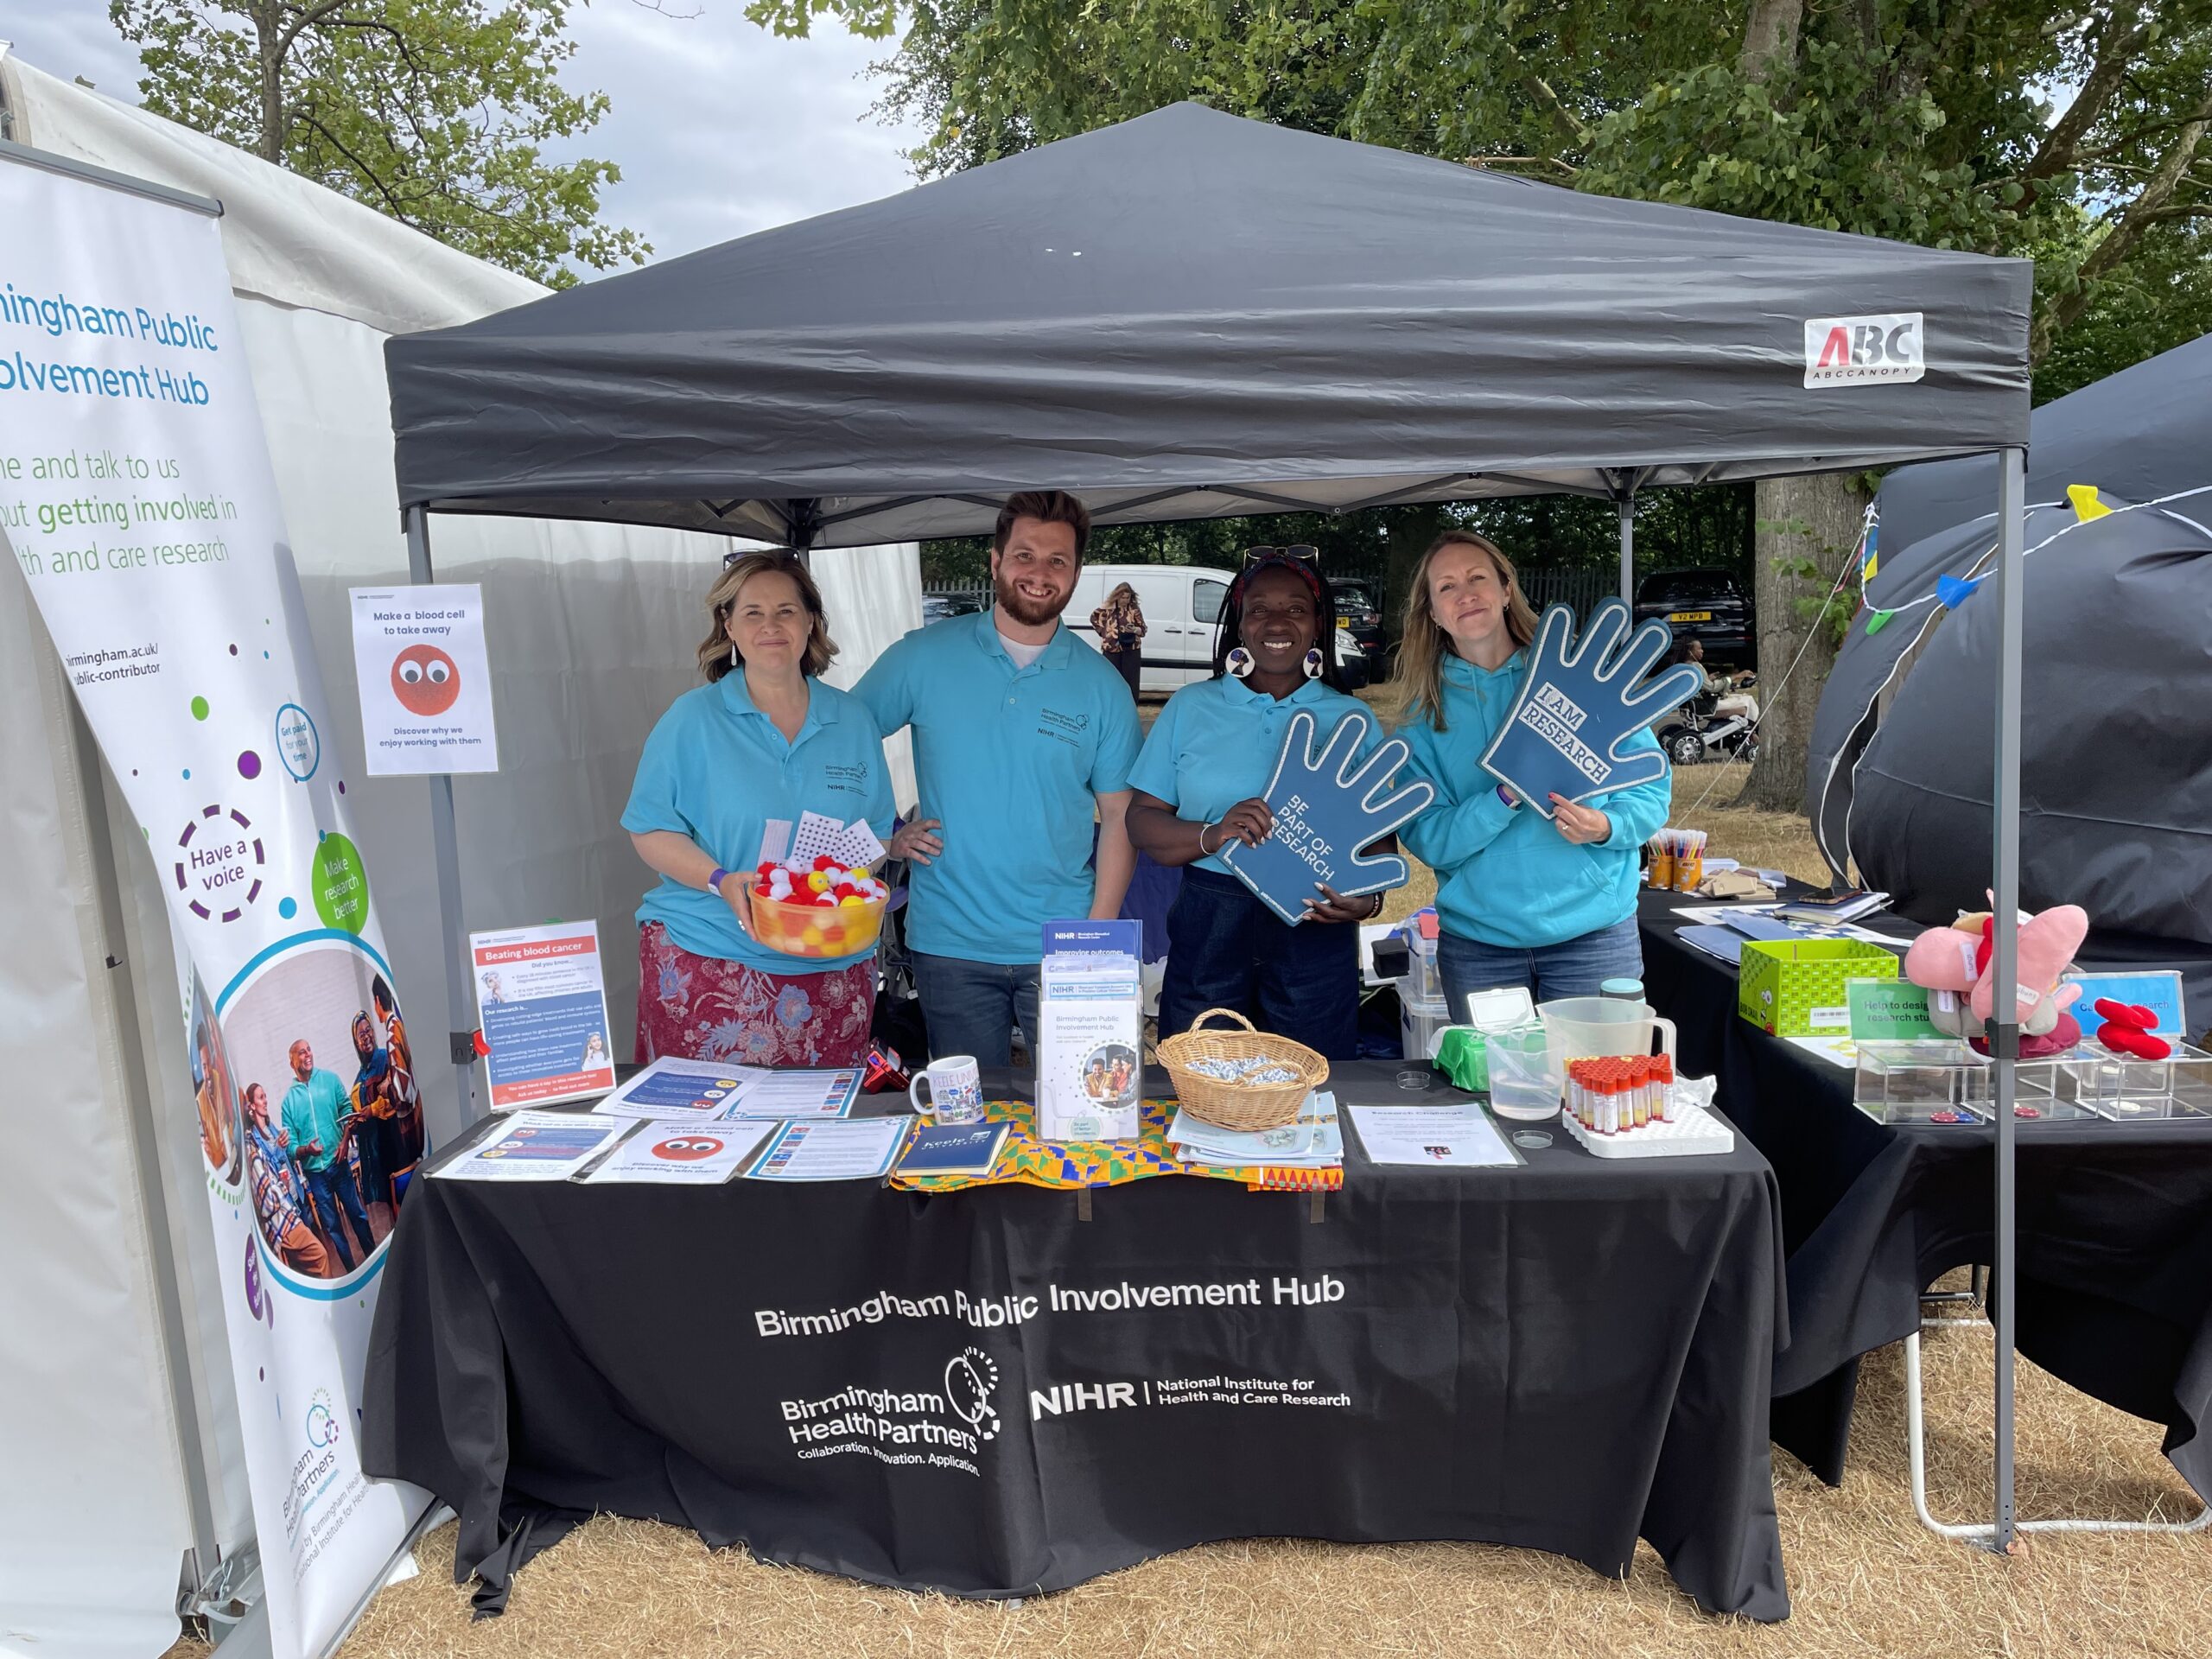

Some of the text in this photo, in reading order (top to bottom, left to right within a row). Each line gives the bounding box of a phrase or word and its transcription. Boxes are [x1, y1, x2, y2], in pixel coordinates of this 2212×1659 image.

[136, 308, 219, 352] Public
[1816, 322, 1913, 368] ABC
[1813, 366, 1911, 379] ABCCANOPY
[156, 368, 210, 405] Hub
[32, 449, 79, 479] and
[85, 449, 122, 479] talk
[125, 454, 149, 479] to
[157, 457, 180, 478] us
[38, 495, 129, 533] getting
[134, 493, 219, 522] involved
[221, 495, 238, 519] in
[52, 542, 100, 574] and
[107, 546, 146, 569] care
[153, 535, 230, 565] research
[373, 612, 402, 621] Make
[415, 611, 444, 620] blood
[447, 610, 465, 619] cell
[384, 626, 451, 636] to take away
[1538, 687, 1584, 727] I AM
[292, 722, 307, 735] paid
[431, 728, 448, 737] why
[1037, 728, 1055, 738] NIHR
[379, 740, 403, 748] enjoy
[404, 738, 438, 747] working
[439, 737, 457, 746] with
[1523, 706, 1609, 782] RESEARCH
[1287, 794, 1310, 817] BE
[1277, 806, 1333, 856] PART OF
[190, 840, 248, 870] Have a
[1271, 819, 1335, 881] RESEARCH
[201, 865, 245, 892] voice
[325, 857, 349, 879] Make
[325, 874, 359, 901] research
[334, 896, 359, 920] better
[485, 942, 582, 962] Beating blood cancer
[1865, 1001, 1888, 1012] Help
[1890, 1001, 1899, 1010] to
[1867, 1013, 1911, 1022] research
[924, 1138, 966, 1147] Keele
[754, 1274, 1345, 1338] Birmingham Public Involvement Hub
[780, 1383, 945, 1421] Birmingham
[1029, 1376, 1315, 1421] NIHR National Institute for
[1158, 1390, 1352, 1407] Health and Care Research
[787, 1412, 978, 1454] Health Partners
[797, 1440, 981, 1477] Collaboration. Innovation. Application.
